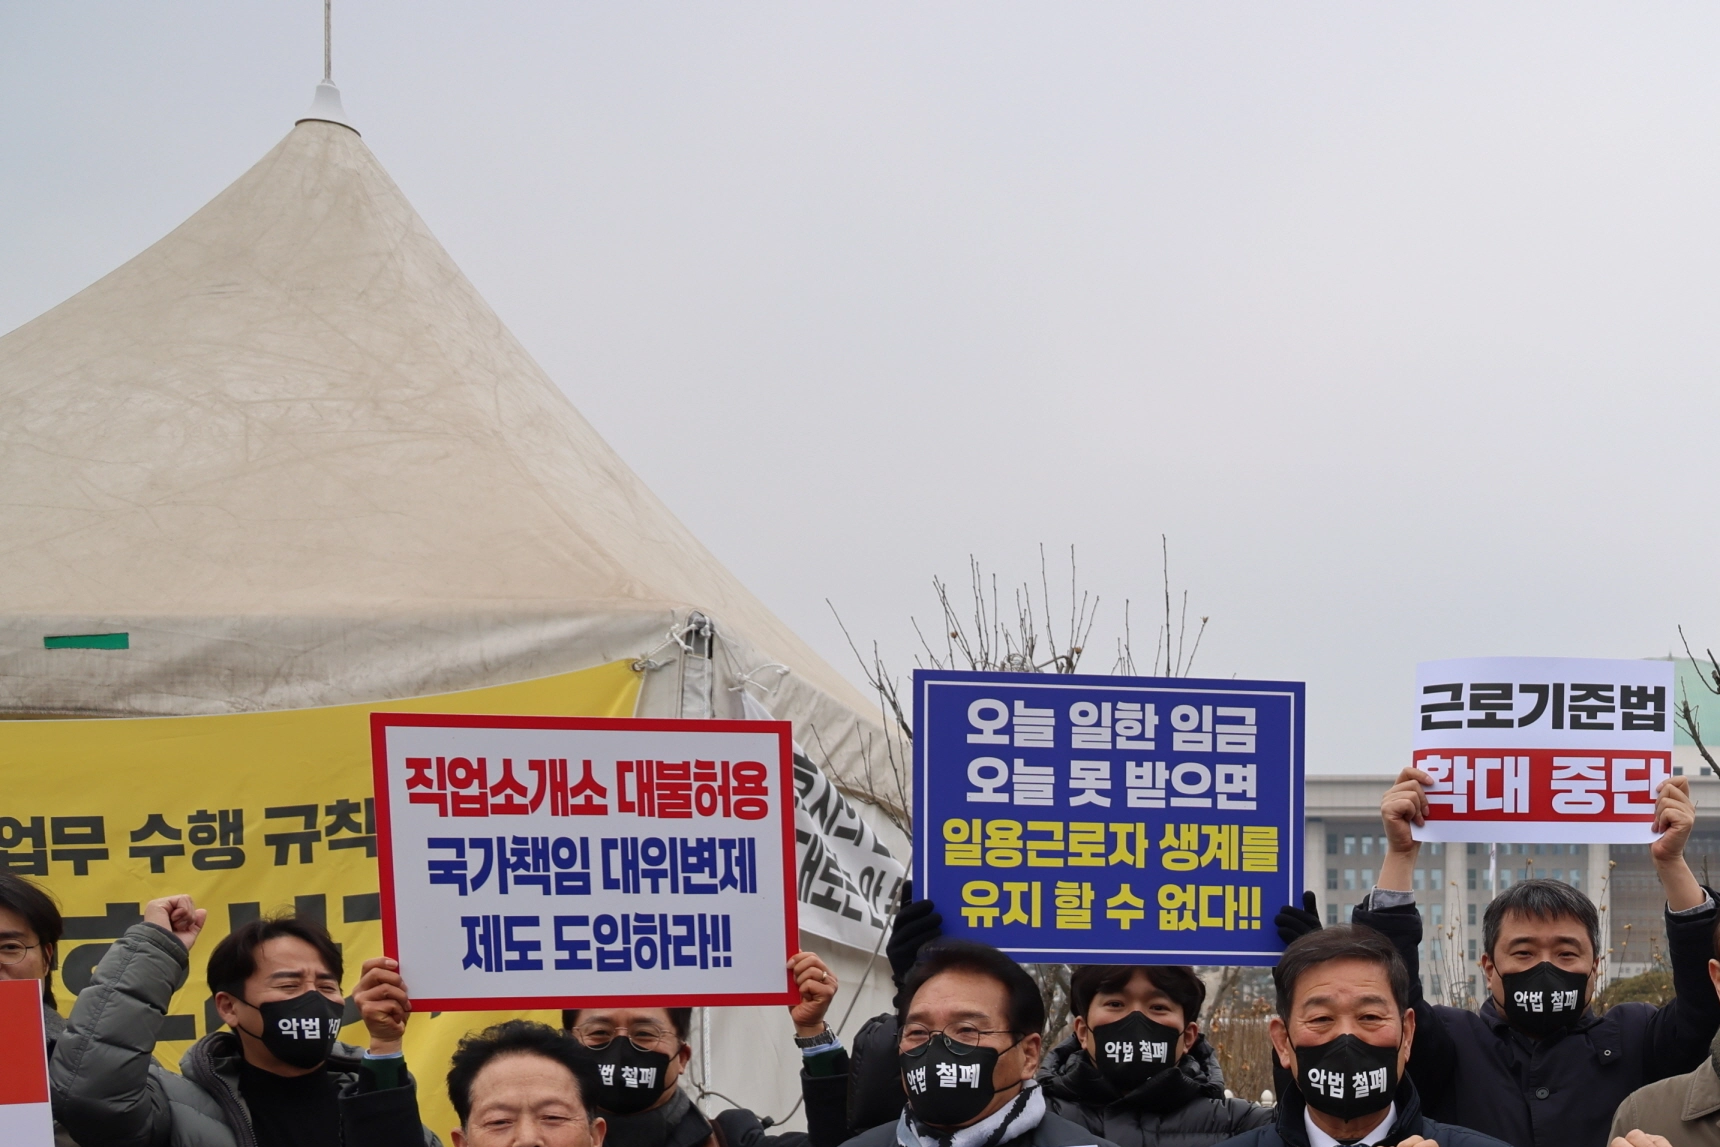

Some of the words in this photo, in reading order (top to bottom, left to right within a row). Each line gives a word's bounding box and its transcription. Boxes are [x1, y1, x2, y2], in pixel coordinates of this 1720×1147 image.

[966, 698, 1055, 748] 오늘
[1068, 701, 1159, 750] 일한
[1170, 705, 1257, 753] 임금
[1420, 682, 1666, 732] 근로기준법
[405, 757, 608, 818] 직업소개소
[616, 759, 769, 820] 대불허용
[966, 756, 1055, 806] 오늘
[1068, 760, 1111, 808] 못
[1125, 760, 1257, 810] 받으면
[1416, 754, 1530, 814] 확대
[1550, 756, 1670, 814] 중단
[0, 815, 109, 876] 업무
[129, 808, 246, 874] 수행
[264, 797, 378, 866] 규칙
[942, 818, 1149, 869] 일용근로자
[1158, 823, 1279, 872] 생계를
[427, 835, 591, 896] 국가책임
[601, 837, 757, 895] 대위변제
[961, 880, 1041, 928] 유지
[1054, 880, 1095, 930] 할
[1106, 883, 1145, 930] 수
[1157, 884, 1261, 931] 없다!!
[461, 914, 543, 973] 제도
[553, 911, 733, 972] 도입하라!!
[1513, 990, 1544, 1013] 악법
[1550, 989, 1578, 1013] 철폐
[278, 1017, 321, 1040] 악법
[1104, 1041, 1133, 1063] 악법
[1139, 1040, 1168, 1064] 철폐
[621, 1066, 657, 1089] 철폐
[907, 1065, 926, 1095] 악법
[935, 1062, 981, 1089] 철폐
[1308, 1067, 1344, 1099] 악법
[1352, 1067, 1387, 1099] 철폐
